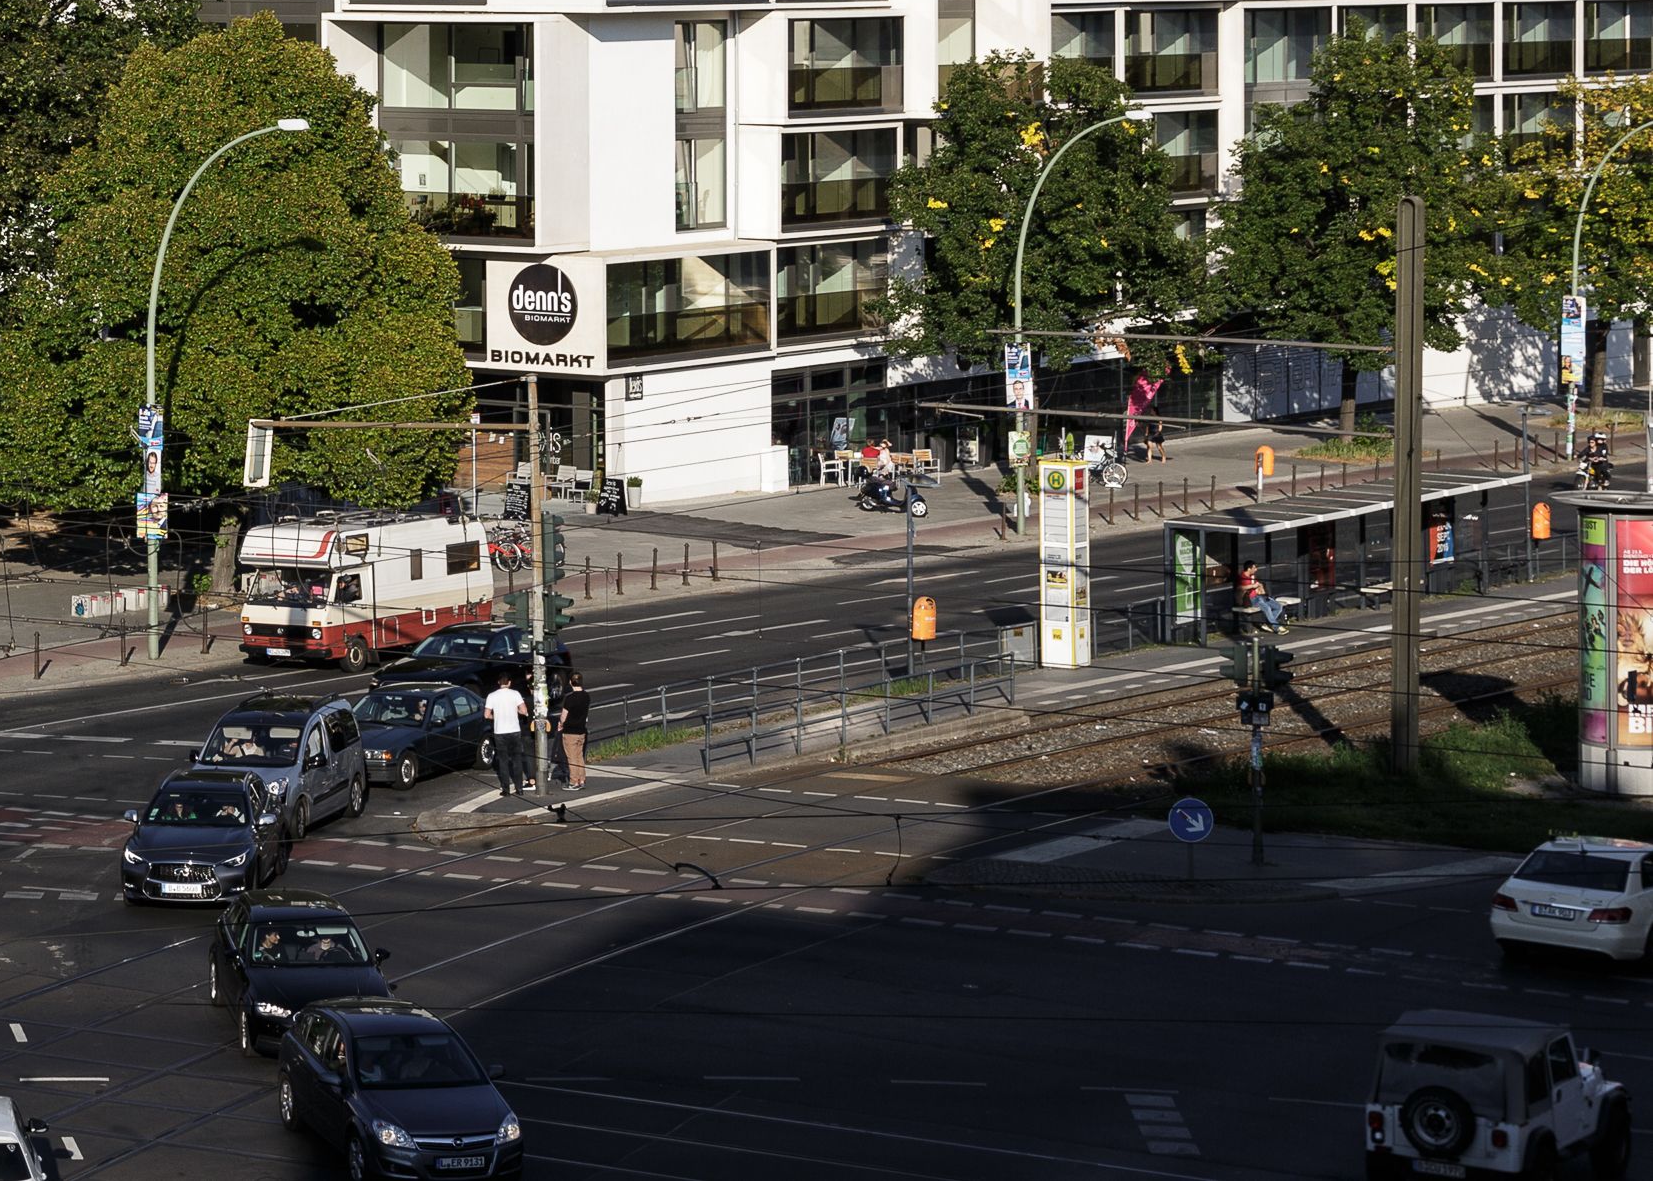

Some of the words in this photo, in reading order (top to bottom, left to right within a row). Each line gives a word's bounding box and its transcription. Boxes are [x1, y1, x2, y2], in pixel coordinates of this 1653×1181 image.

[512, 268, 572, 313] denn's
[524, 314, 572, 324] BIOMARKT
[490, 349, 595, 368] BIOMARKT
